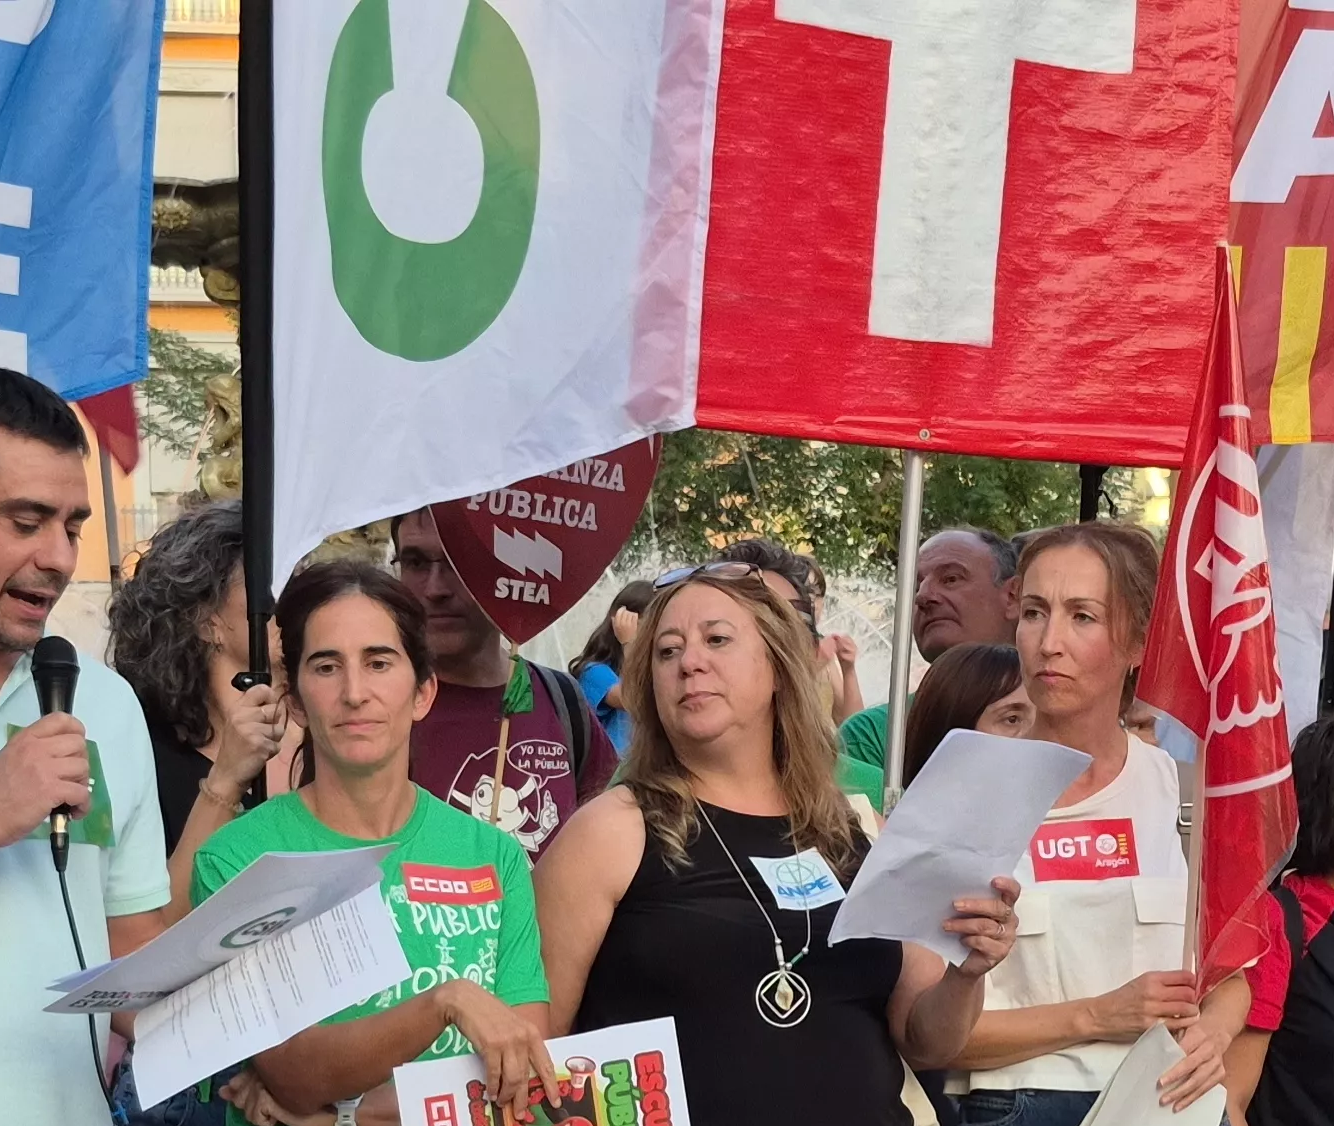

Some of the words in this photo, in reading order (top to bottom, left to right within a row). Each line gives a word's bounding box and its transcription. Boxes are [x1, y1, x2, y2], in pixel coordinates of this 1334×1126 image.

[494, 577, 551, 605] STEA
[1037, 835, 1092, 860] UGT
[1095, 856, 1130, 869] Aragón
[409, 876, 469, 894] CCOO
[777, 874, 834, 898] ANPE
